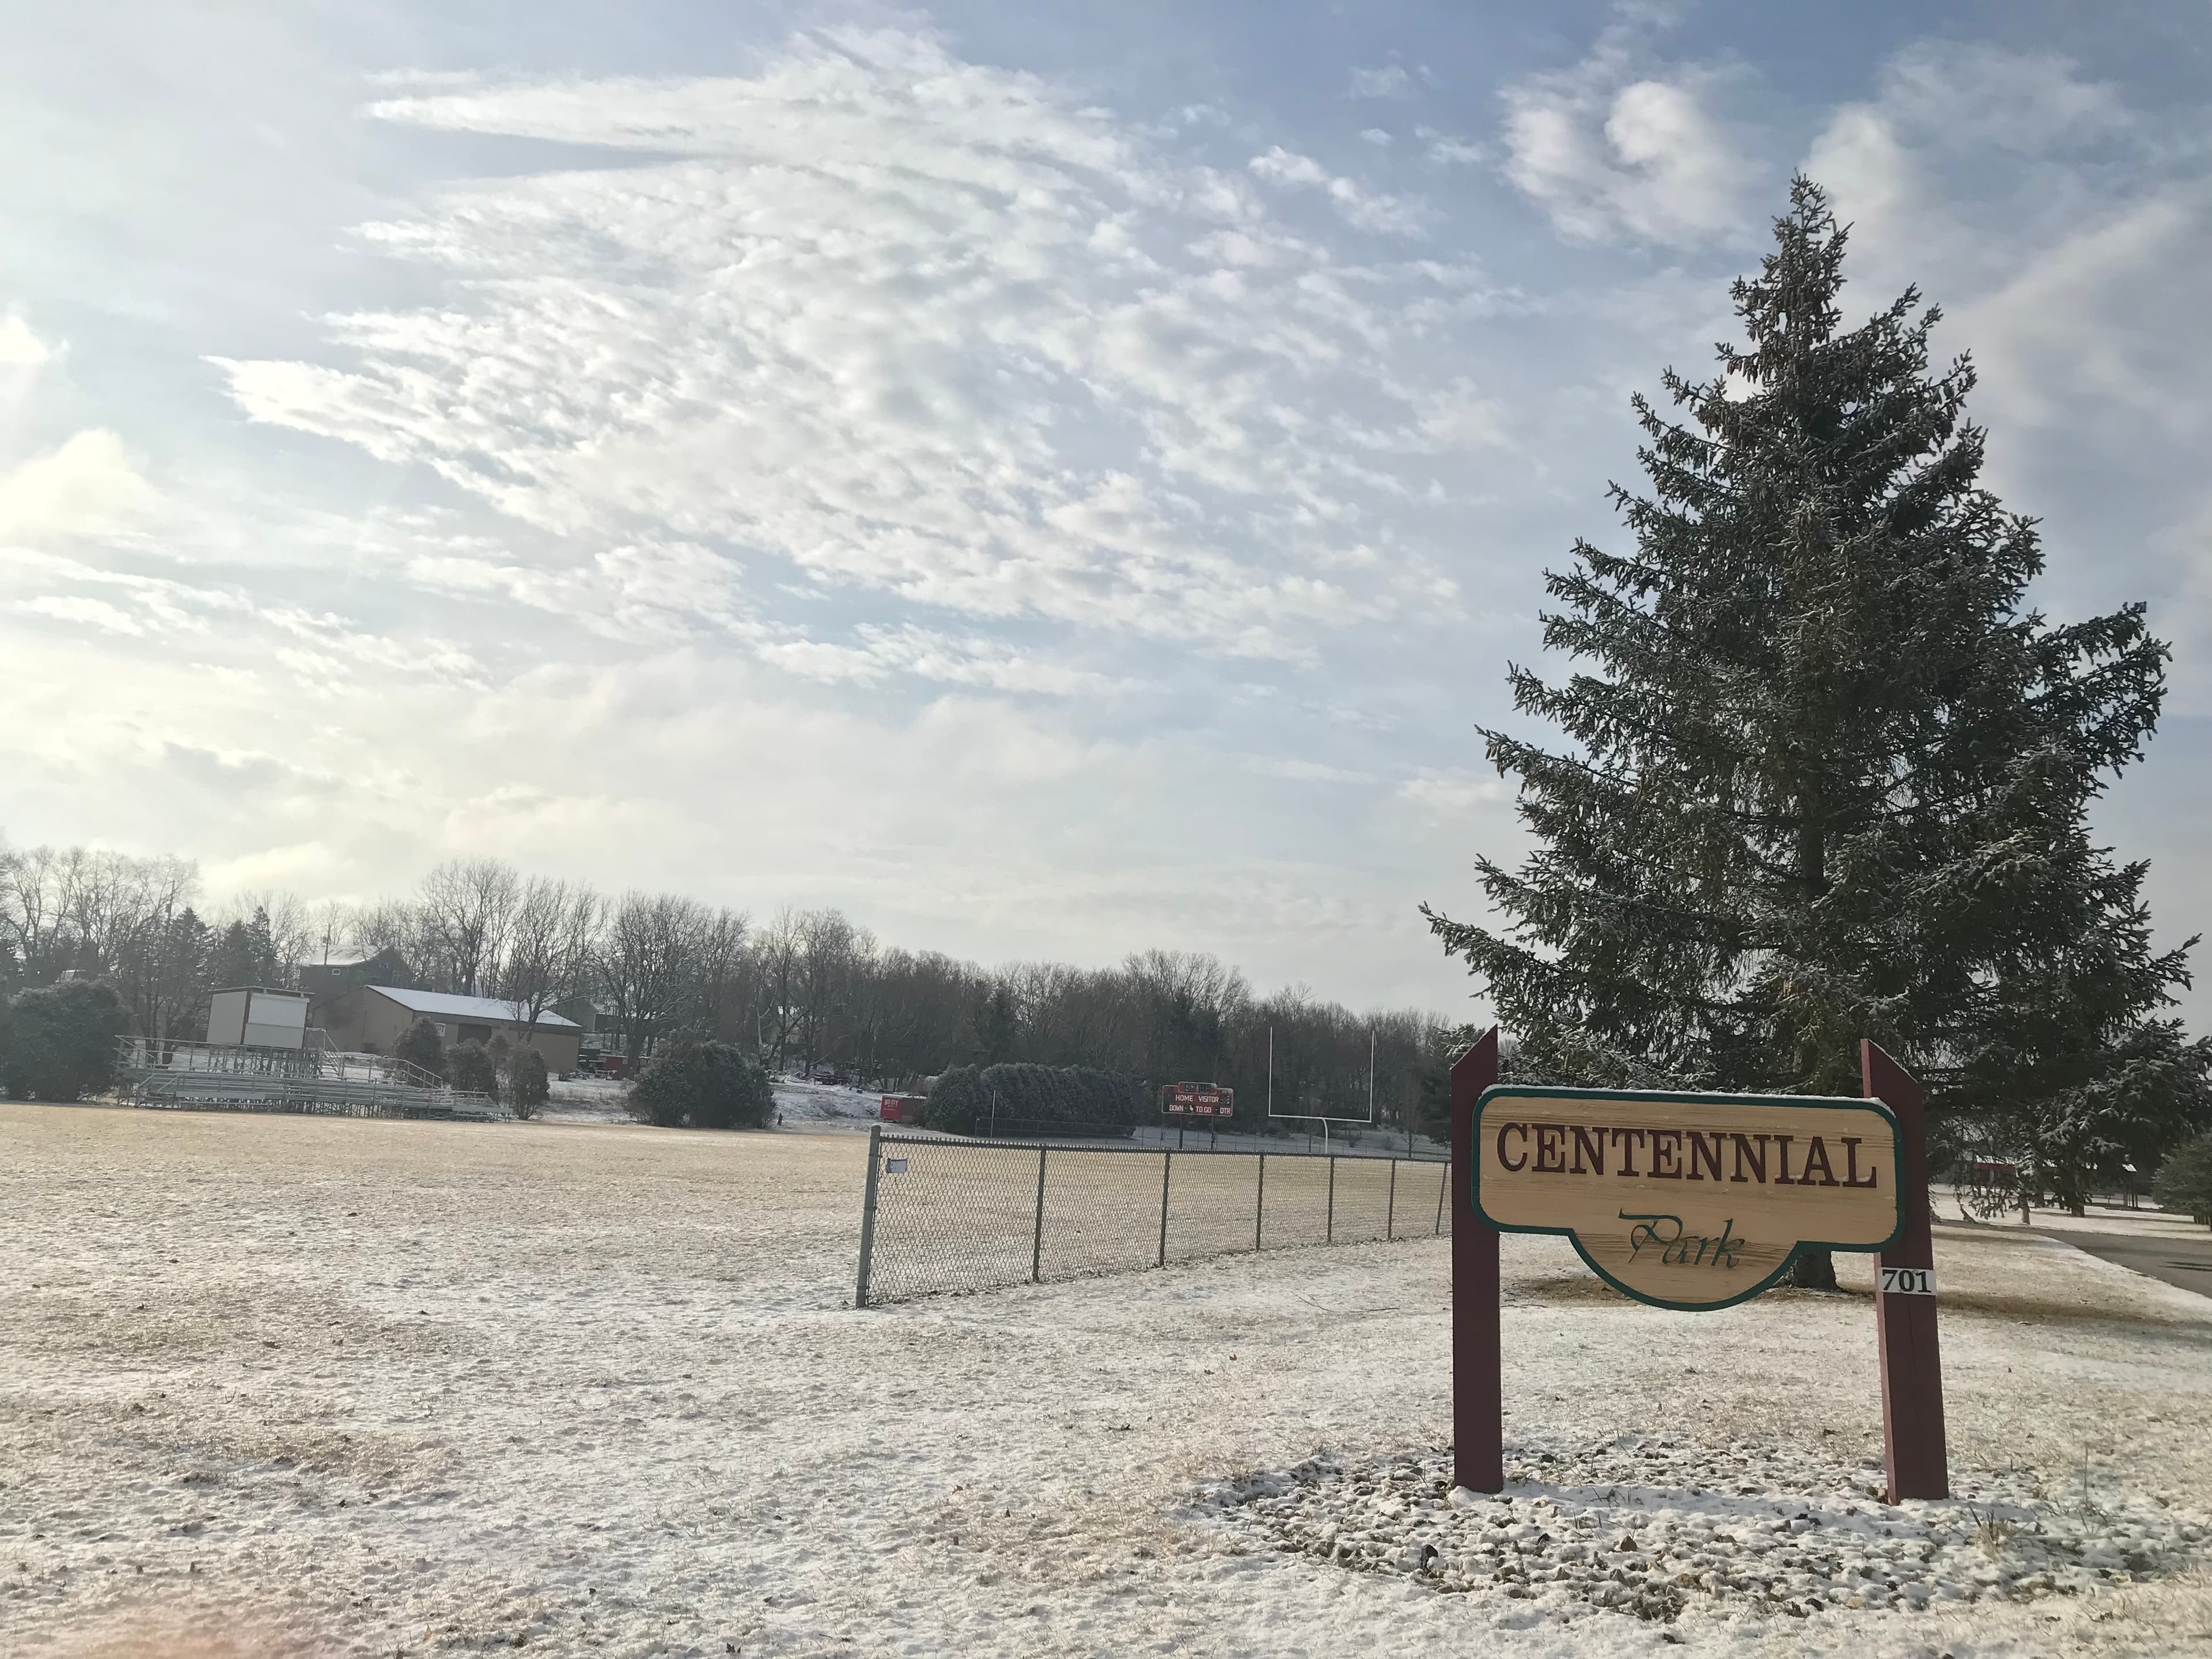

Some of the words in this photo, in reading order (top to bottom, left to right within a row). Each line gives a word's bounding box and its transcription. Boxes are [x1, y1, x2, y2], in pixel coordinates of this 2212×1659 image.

[1497, 1122, 1877, 1188] CENTENNIAL
[1618, 1209, 1745, 1268] Park
[1882, 1269, 1931, 1293] 701
